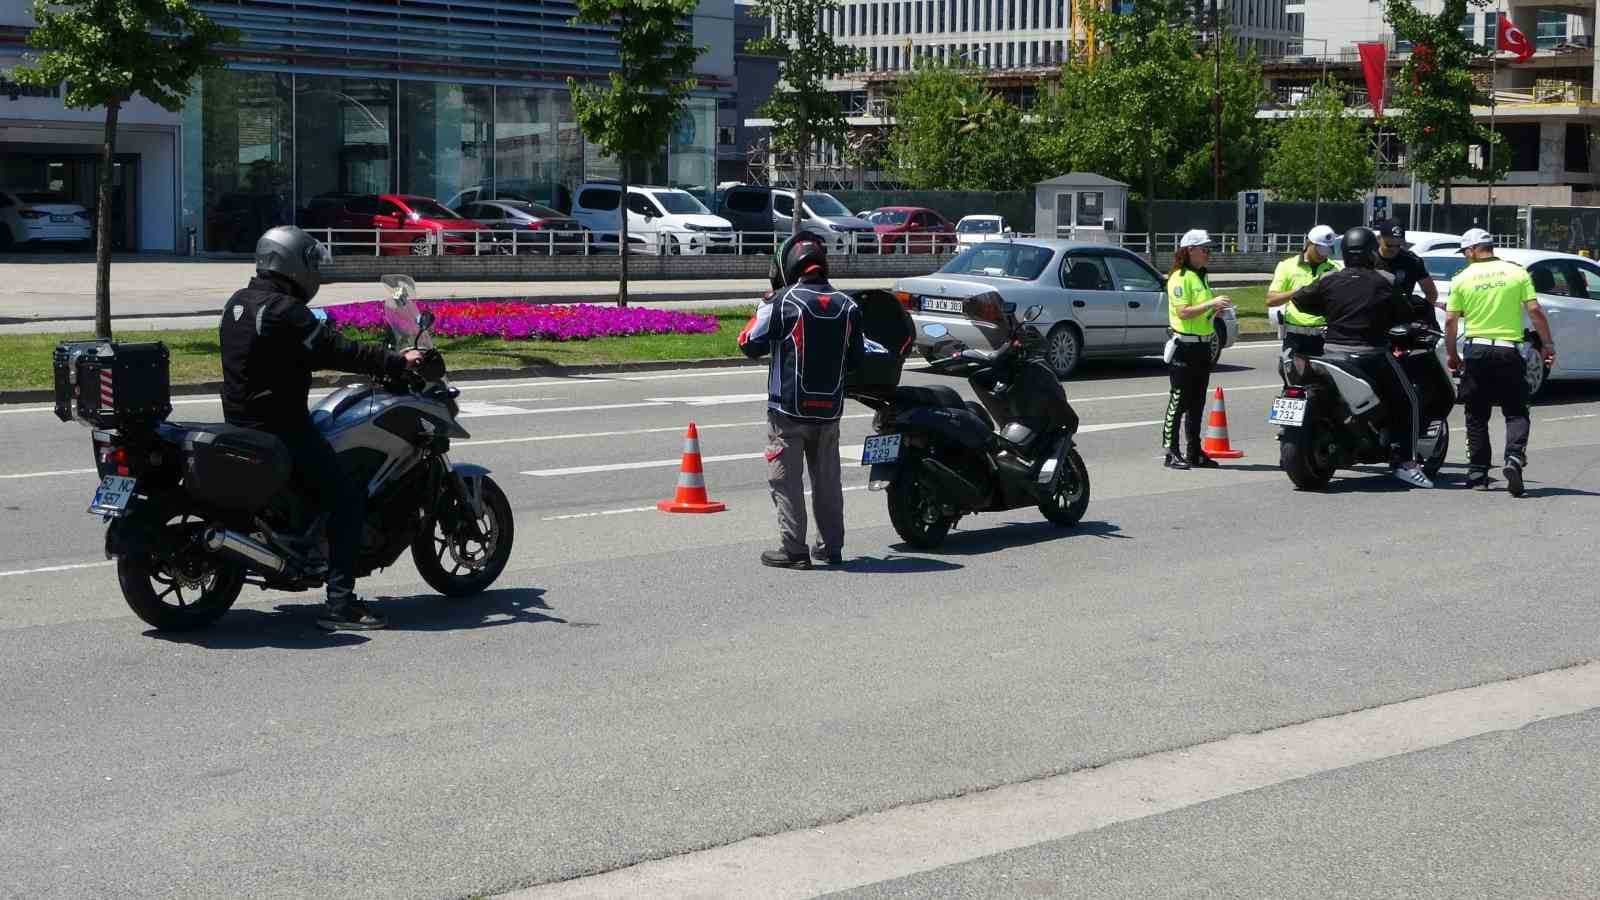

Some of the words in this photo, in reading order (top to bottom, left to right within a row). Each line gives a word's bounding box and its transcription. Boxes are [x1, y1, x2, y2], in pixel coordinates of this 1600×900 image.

[1274, 399, 1285, 409] 52
[1287, 400, 1304, 411] AGJ
[1279, 410, 1295, 419] 732
[867, 438, 880, 449] 52
[881, 435, 900, 449] AFZ
